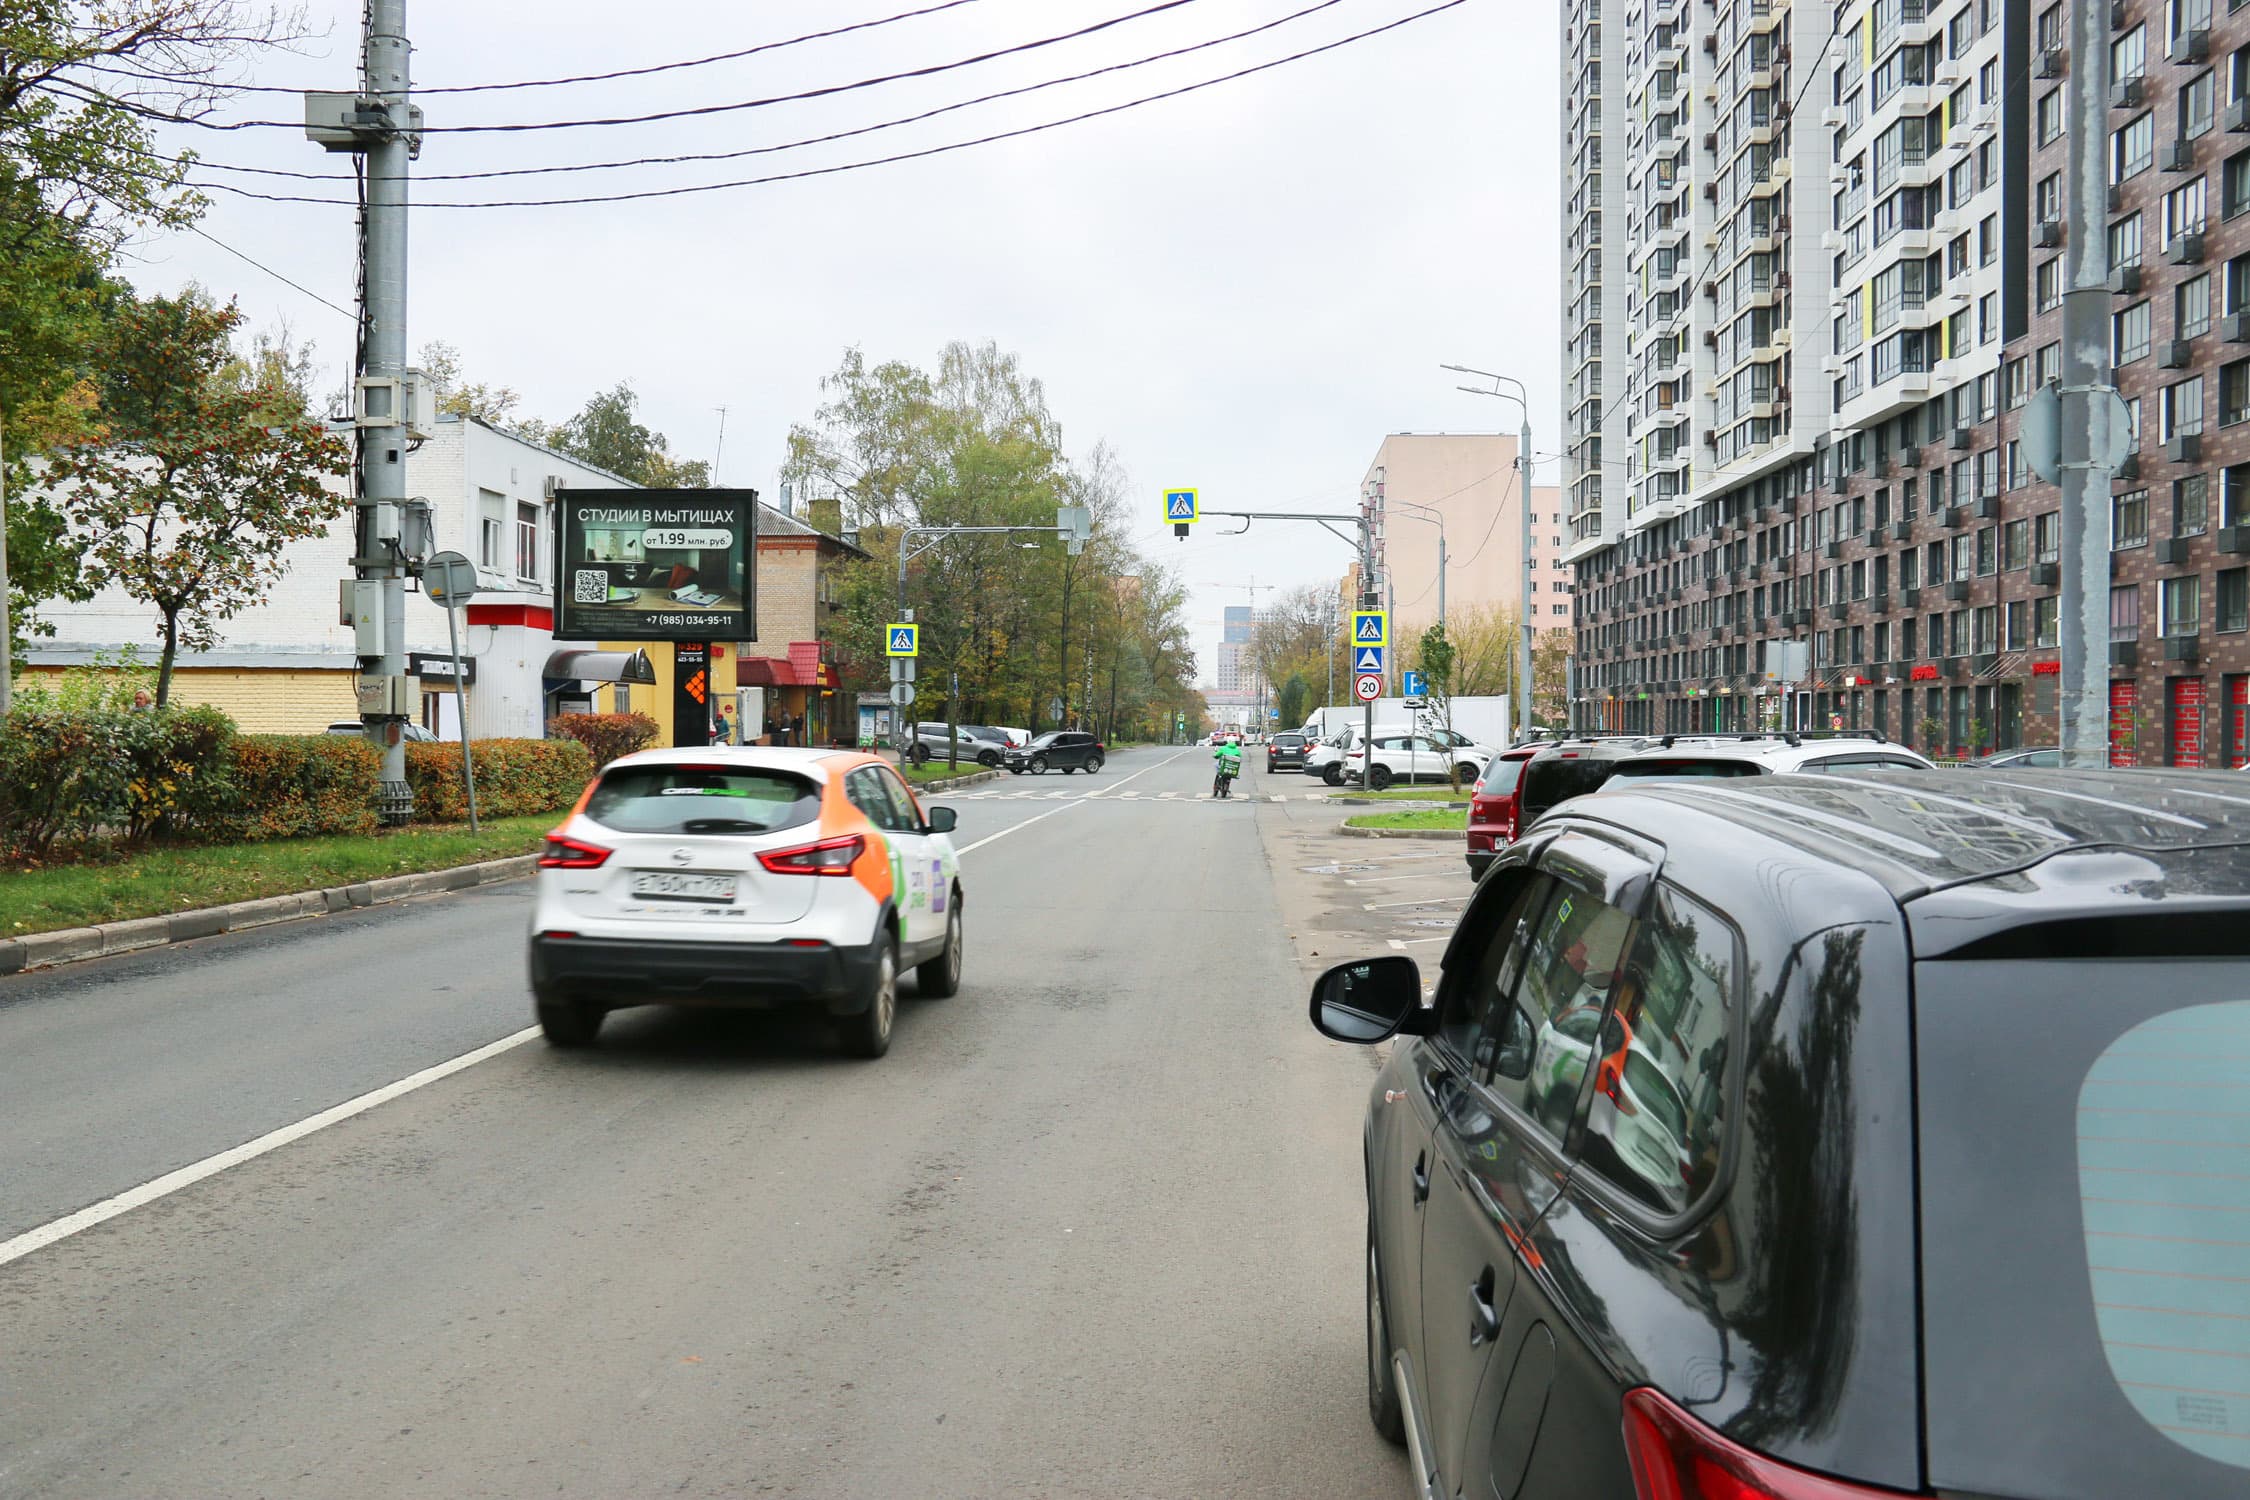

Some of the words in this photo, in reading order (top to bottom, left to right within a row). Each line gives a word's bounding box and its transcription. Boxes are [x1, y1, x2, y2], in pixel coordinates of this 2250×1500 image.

[578, 508, 639, 524] СТУДИИ
[642, 509, 652, 521] В
[654, 509, 734, 524] МЫТИЩАХ
[646, 537, 657, 545] от
[659, 533, 685, 545] 1.99
[645, 616, 657, 626] +7
[659, 614, 685, 627] (985)
[686, 616, 732, 626] 034-95-11
[1361, 682, 1376, 693] 20
